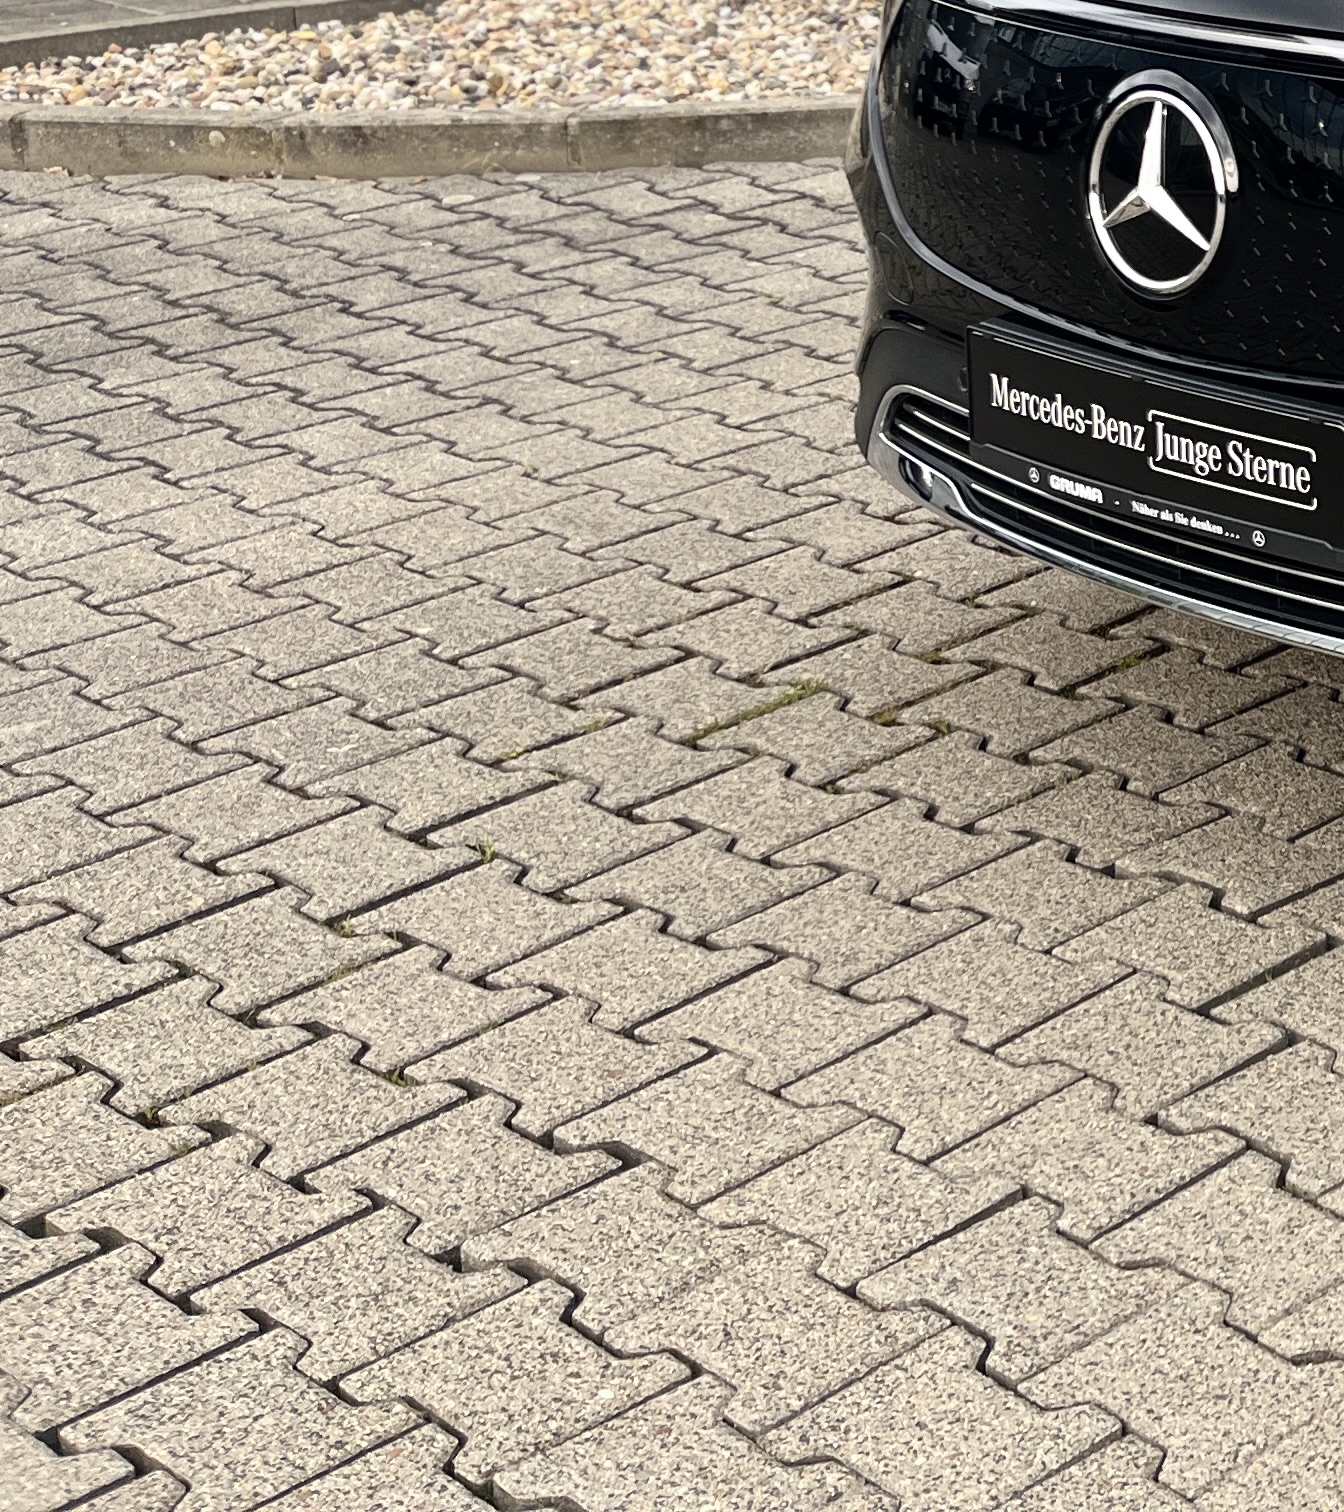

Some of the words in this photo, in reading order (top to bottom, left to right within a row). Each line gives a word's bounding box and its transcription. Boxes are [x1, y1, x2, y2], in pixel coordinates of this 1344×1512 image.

[988, 372, 1147, 453] Mercedes-Benz
[1153, 420, 1223, 476] Junge
[1226, 439, 1312, 495] Sterne
[1049, 474, 1104, 504] GRUMA
[1130, 499, 1160, 519] Näher
[1160, 509, 1175, 523] als
[1174, 512, 1189, 527] Sie
[1190, 516, 1223, 535] denken
